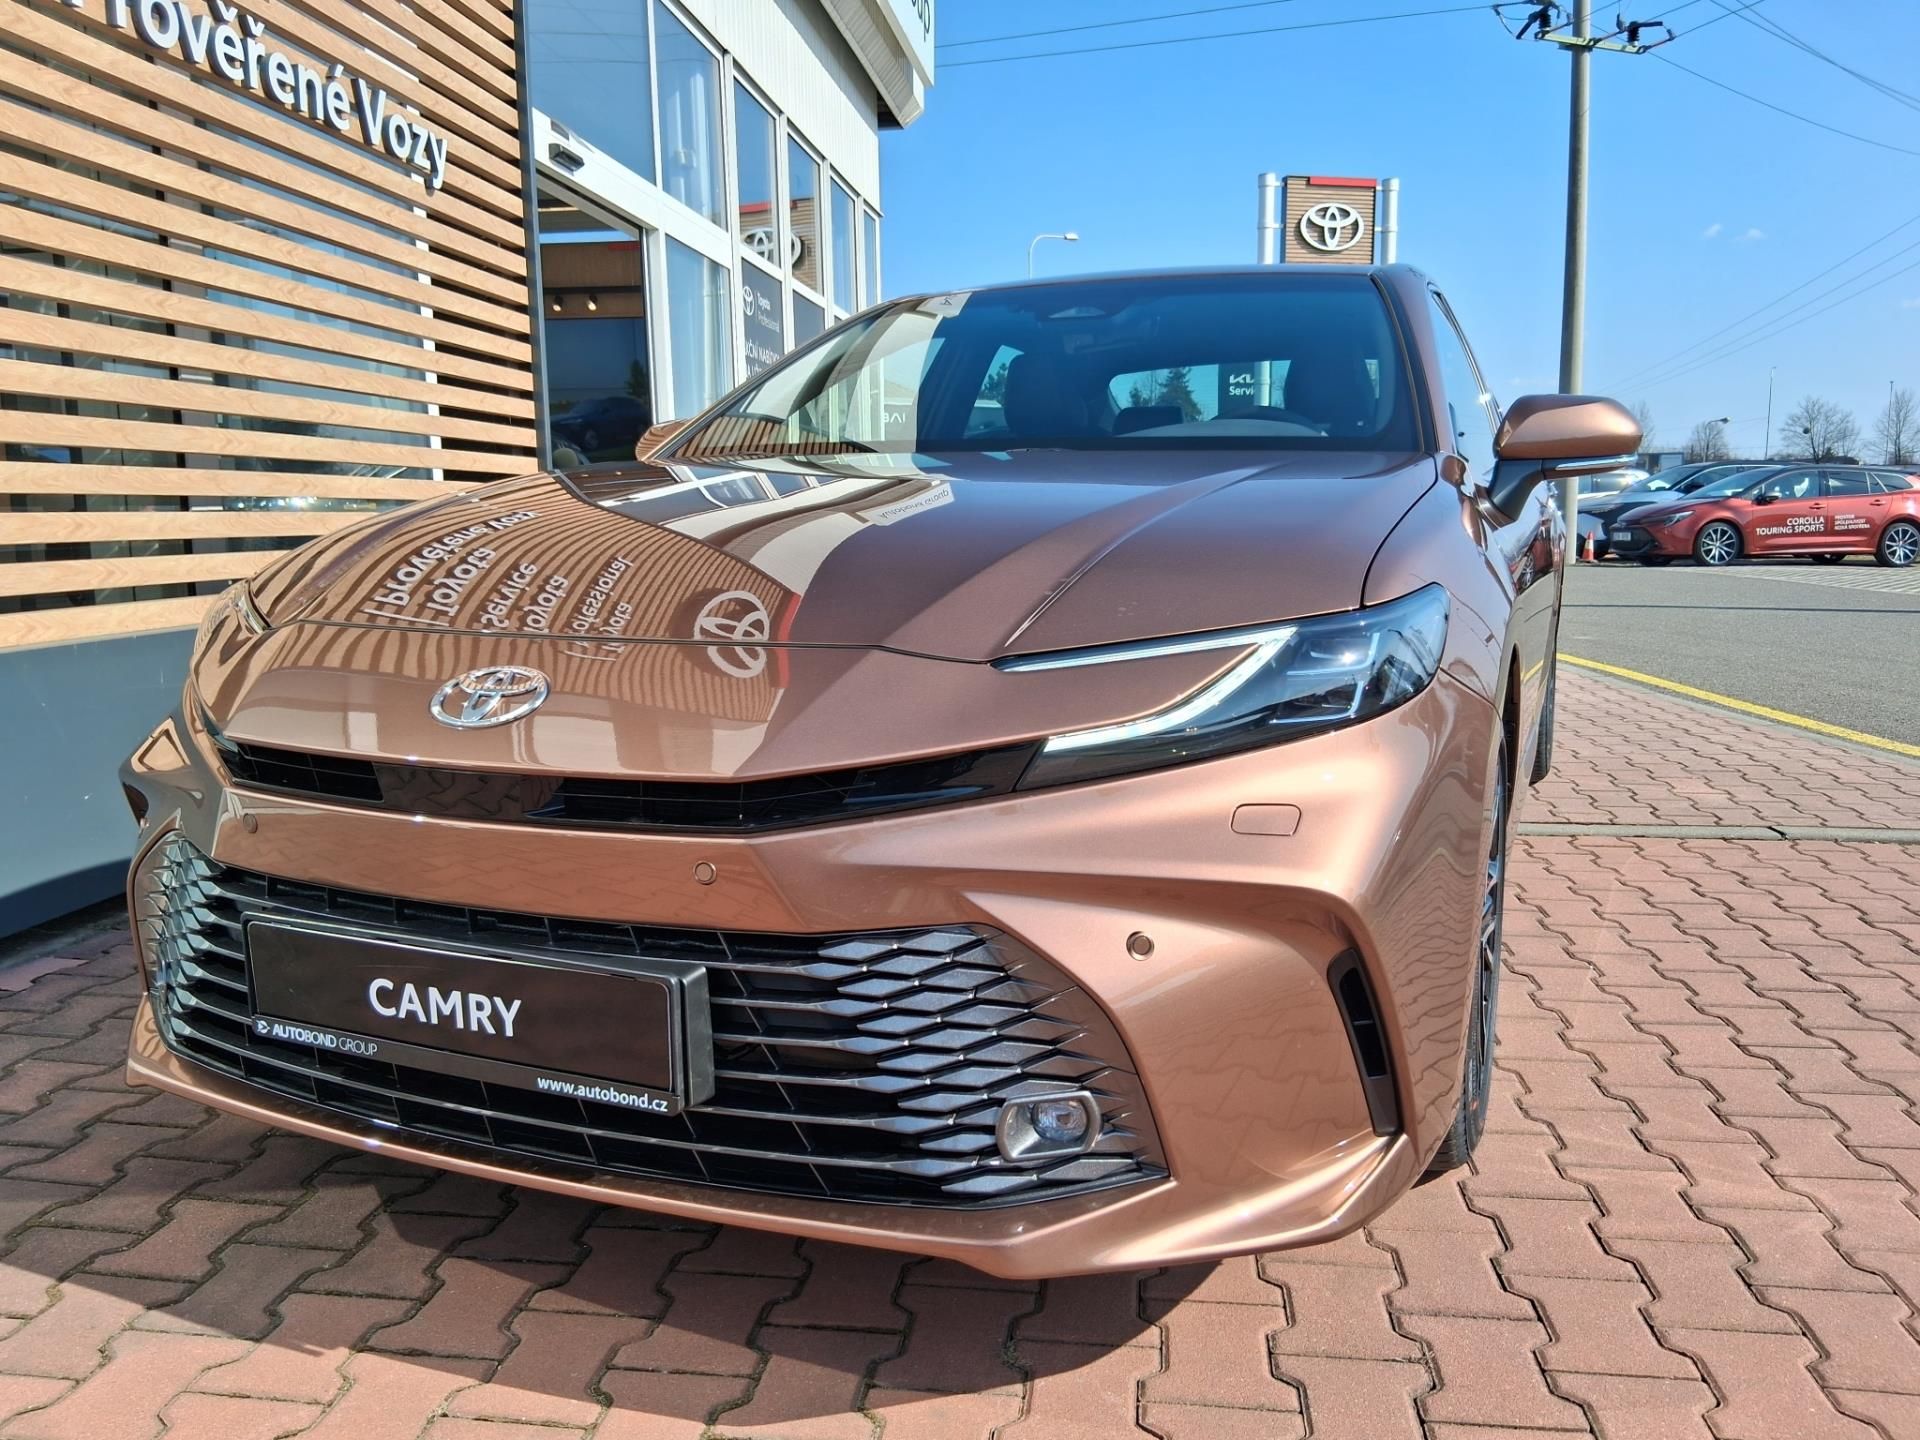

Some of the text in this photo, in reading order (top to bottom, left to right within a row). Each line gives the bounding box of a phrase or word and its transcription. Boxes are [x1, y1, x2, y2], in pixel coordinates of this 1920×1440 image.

[60, 0, 448, 191] ověřené Vozy
[1229, 386, 1254, 395] Servi
[1756, 524, 1825, 535] TOURING SPORTS
[1787, 516, 1825, 526] COROLLA
[368, 978, 523, 1038] CAMRY
[272, 1023, 378, 1056] AUTOBOND GROUP
[537, 1075, 669, 1113] www.autobond.cz
